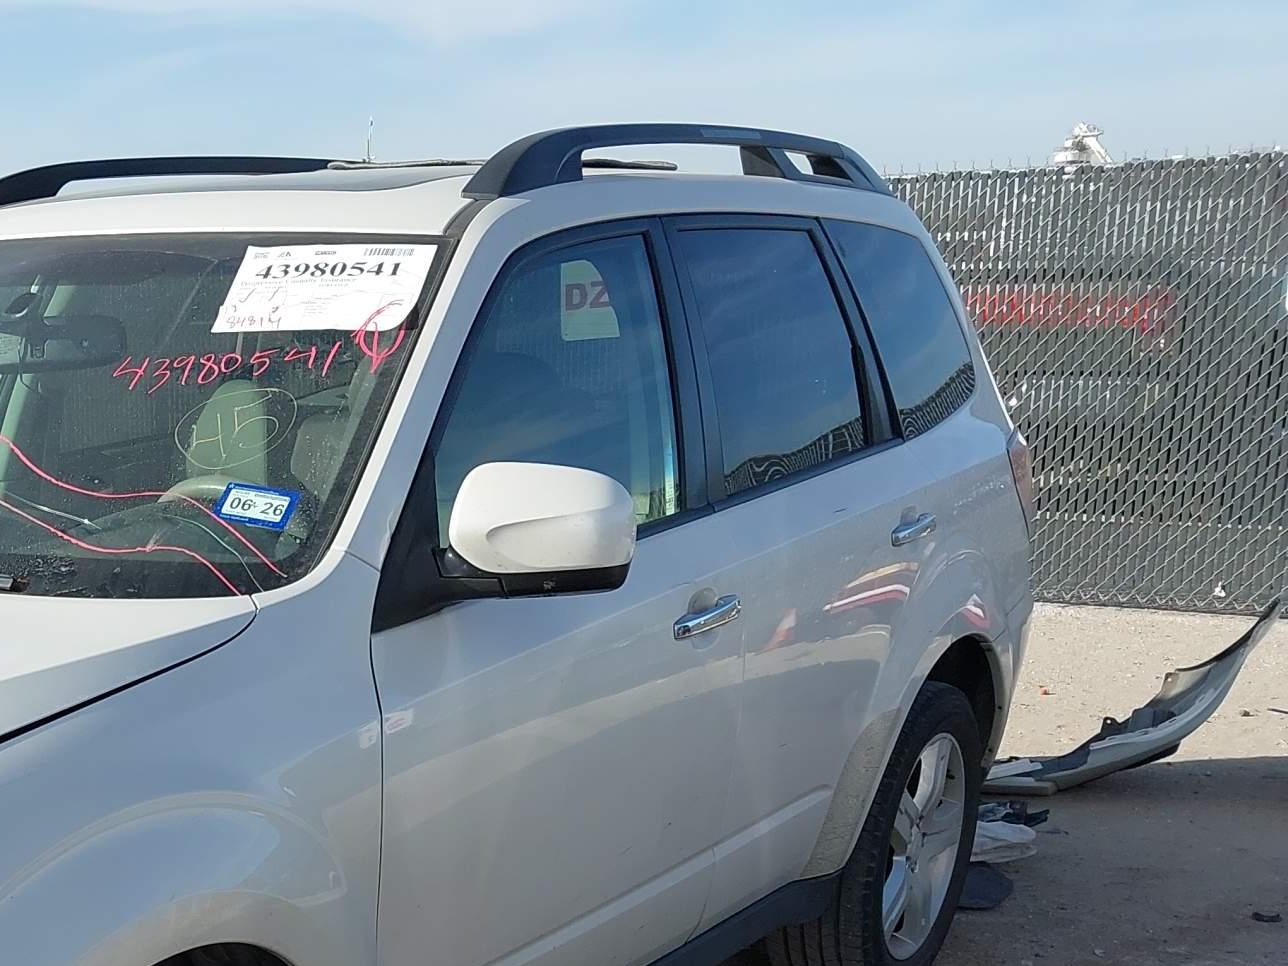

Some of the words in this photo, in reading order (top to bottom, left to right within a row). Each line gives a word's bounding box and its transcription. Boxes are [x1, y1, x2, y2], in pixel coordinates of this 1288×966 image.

[255, 261, 402, 279] 43980541
[112, 341, 342, 394] 43980541
[191, 388, 280, 458] 45
[230, 497, 253, 511] 06
[259, 502, 285, 516] 26
